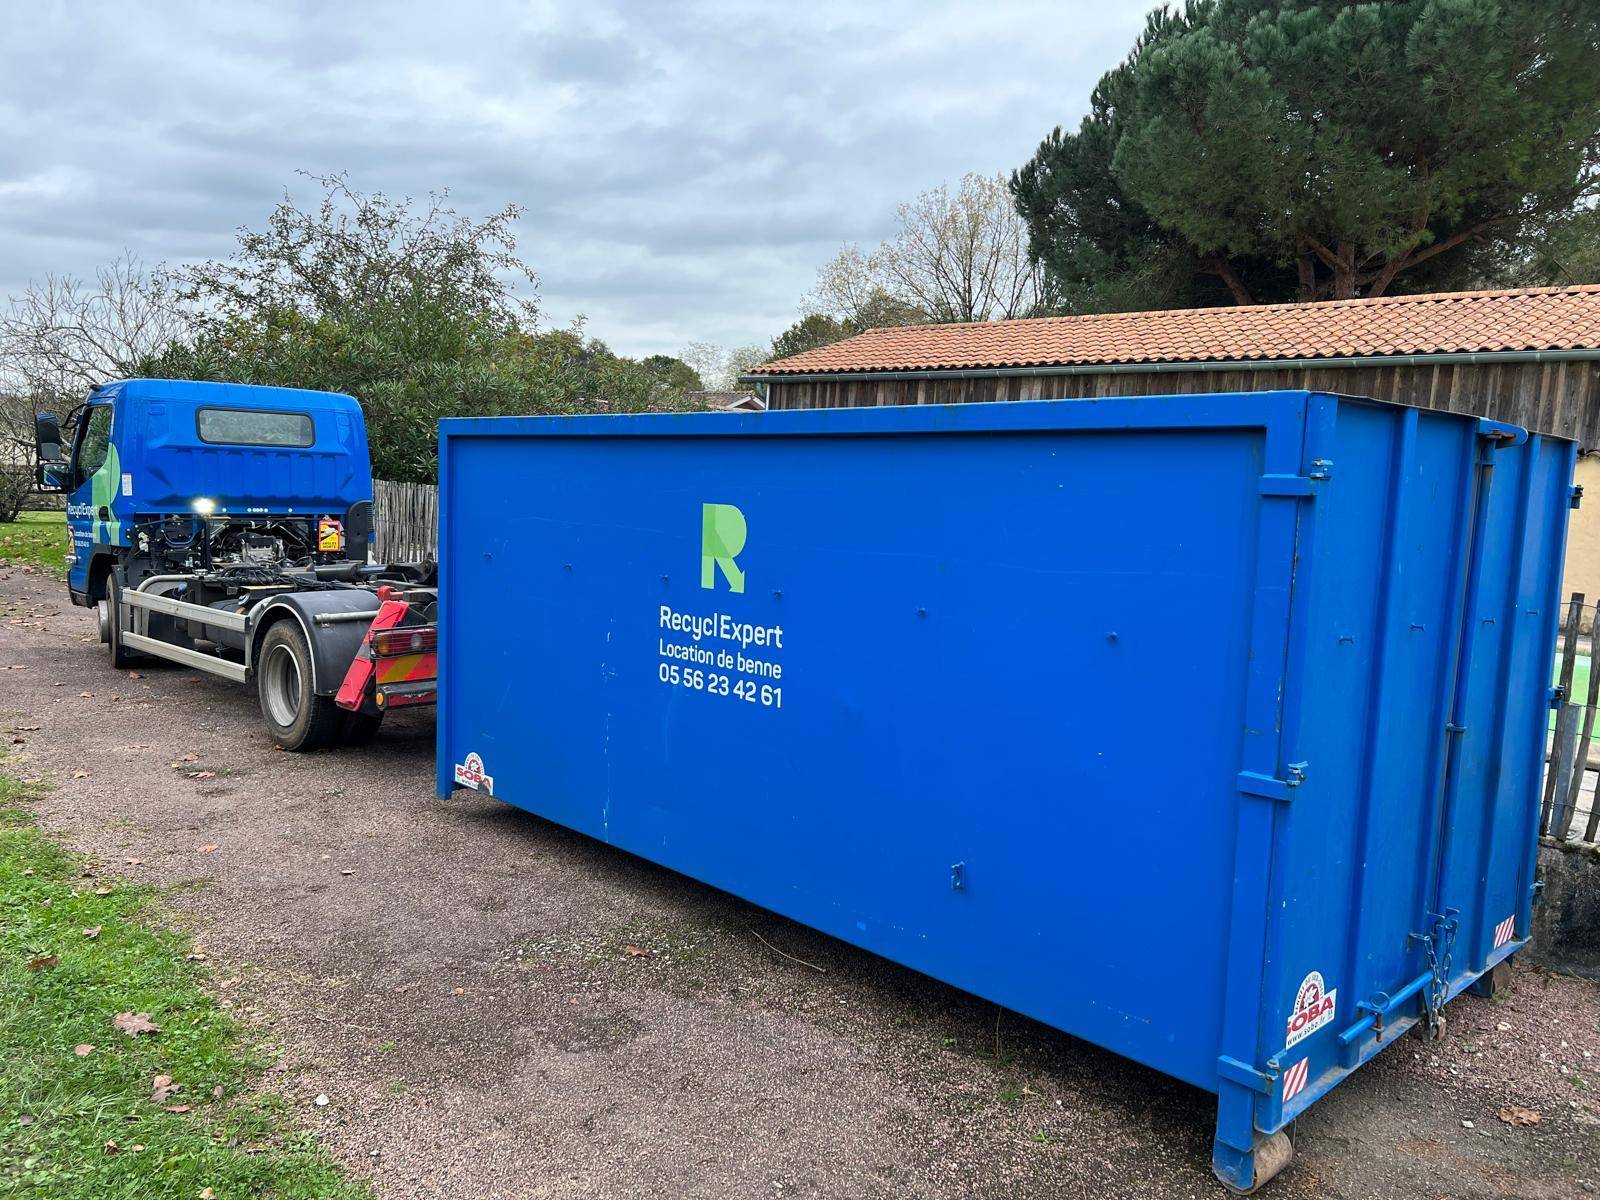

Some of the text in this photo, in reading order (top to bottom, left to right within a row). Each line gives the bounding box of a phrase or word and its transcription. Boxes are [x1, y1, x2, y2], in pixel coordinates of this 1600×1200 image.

[659, 605, 783, 648] RecyclExpert
[659, 638, 782, 679] Location de benne
[659, 662, 782, 708] 05 56 23 42 61
